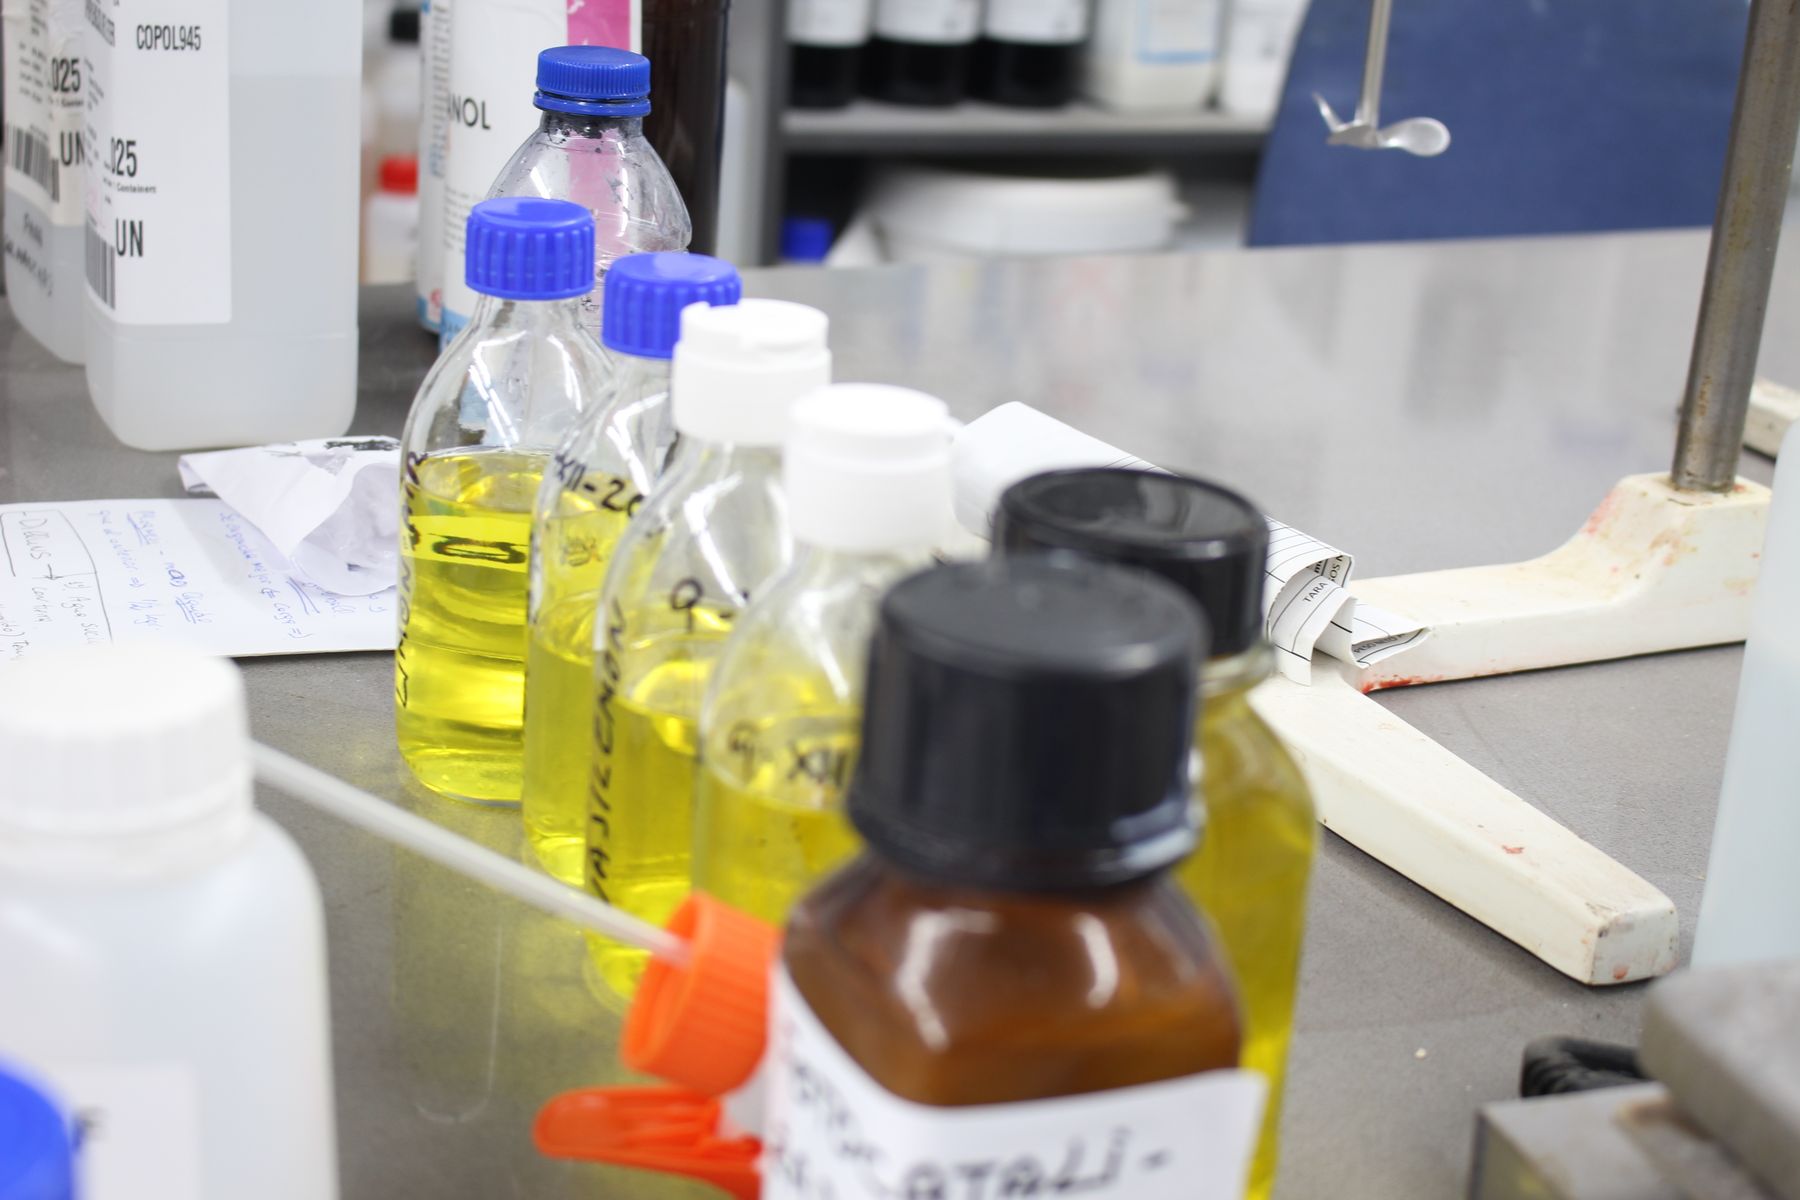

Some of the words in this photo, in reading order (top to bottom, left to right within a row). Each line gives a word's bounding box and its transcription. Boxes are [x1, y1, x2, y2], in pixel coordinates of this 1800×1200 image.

[136, 24, 201, 51] COPOL945
[447, 94, 491, 130] NOL
[115, 219, 143, 257] UN
[1303, 582, 1328, 603] TARA
